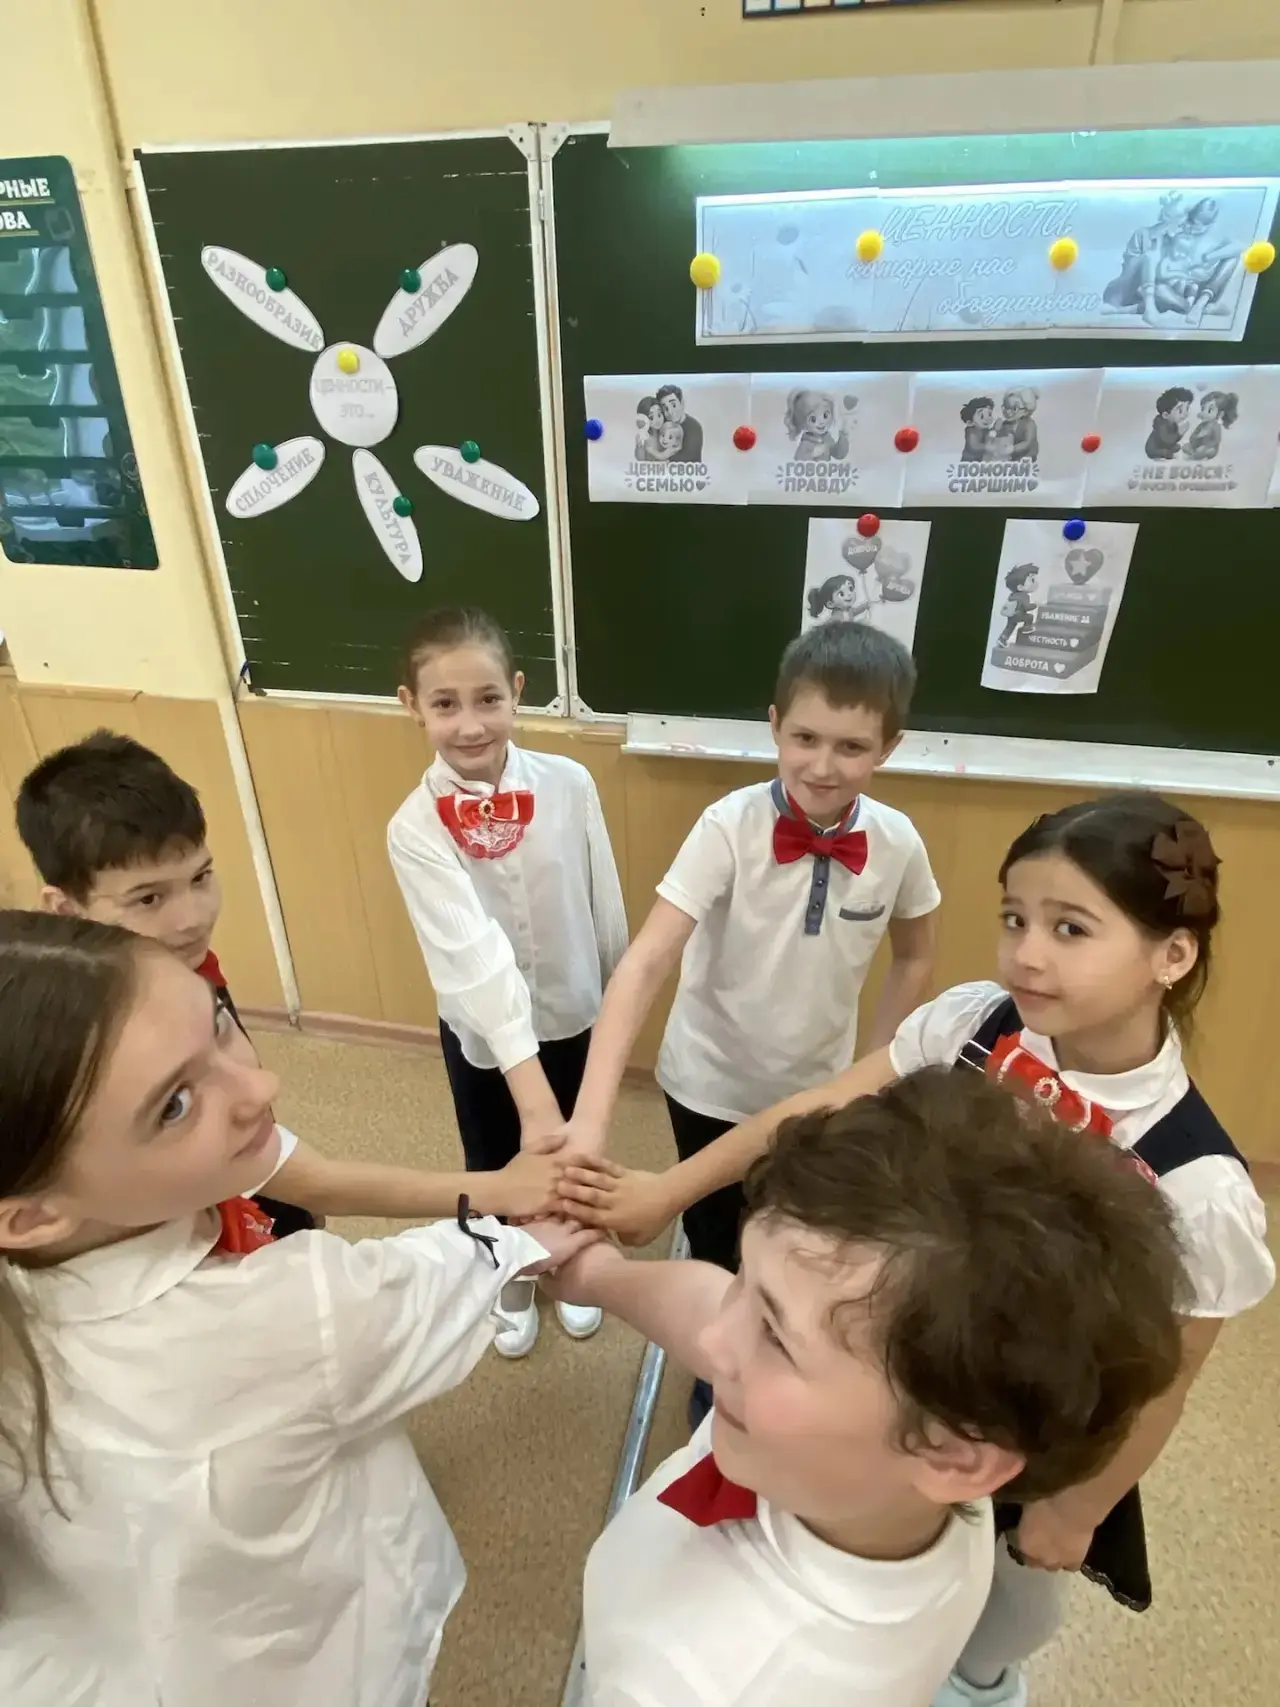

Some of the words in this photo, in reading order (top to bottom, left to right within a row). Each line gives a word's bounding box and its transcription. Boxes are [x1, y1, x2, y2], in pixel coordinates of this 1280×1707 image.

[880, 201, 1078, 246] ЦЕННОСТИ
[968, 257, 1017, 278] нас
[207, 252, 322, 350] РАЗНООБРАЗИЕ
[396, 267, 459, 338] ДРУЖБА
[628, 462, 666, 477] ЦЕНИ
[668, 462, 708, 476] СВОЮ
[785, 462, 851, 477] ГОВОРИ
[957, 459, 1030, 477] ПОМОГАЙ
[1142, 465, 1164, 480] НЕ
[235, 447, 316, 512] СПЛОЧЕНИЕ
[430, 456, 526, 512] УВАЖЕНИЕ
[636, 478, 695, 492] СЕМЬЮ
[784, 478, 851, 494] ПРАВДУ
[949, 479, 1027, 493] СТАРШИМ
[1004, 655, 1049, 672] ДОБРОТА
